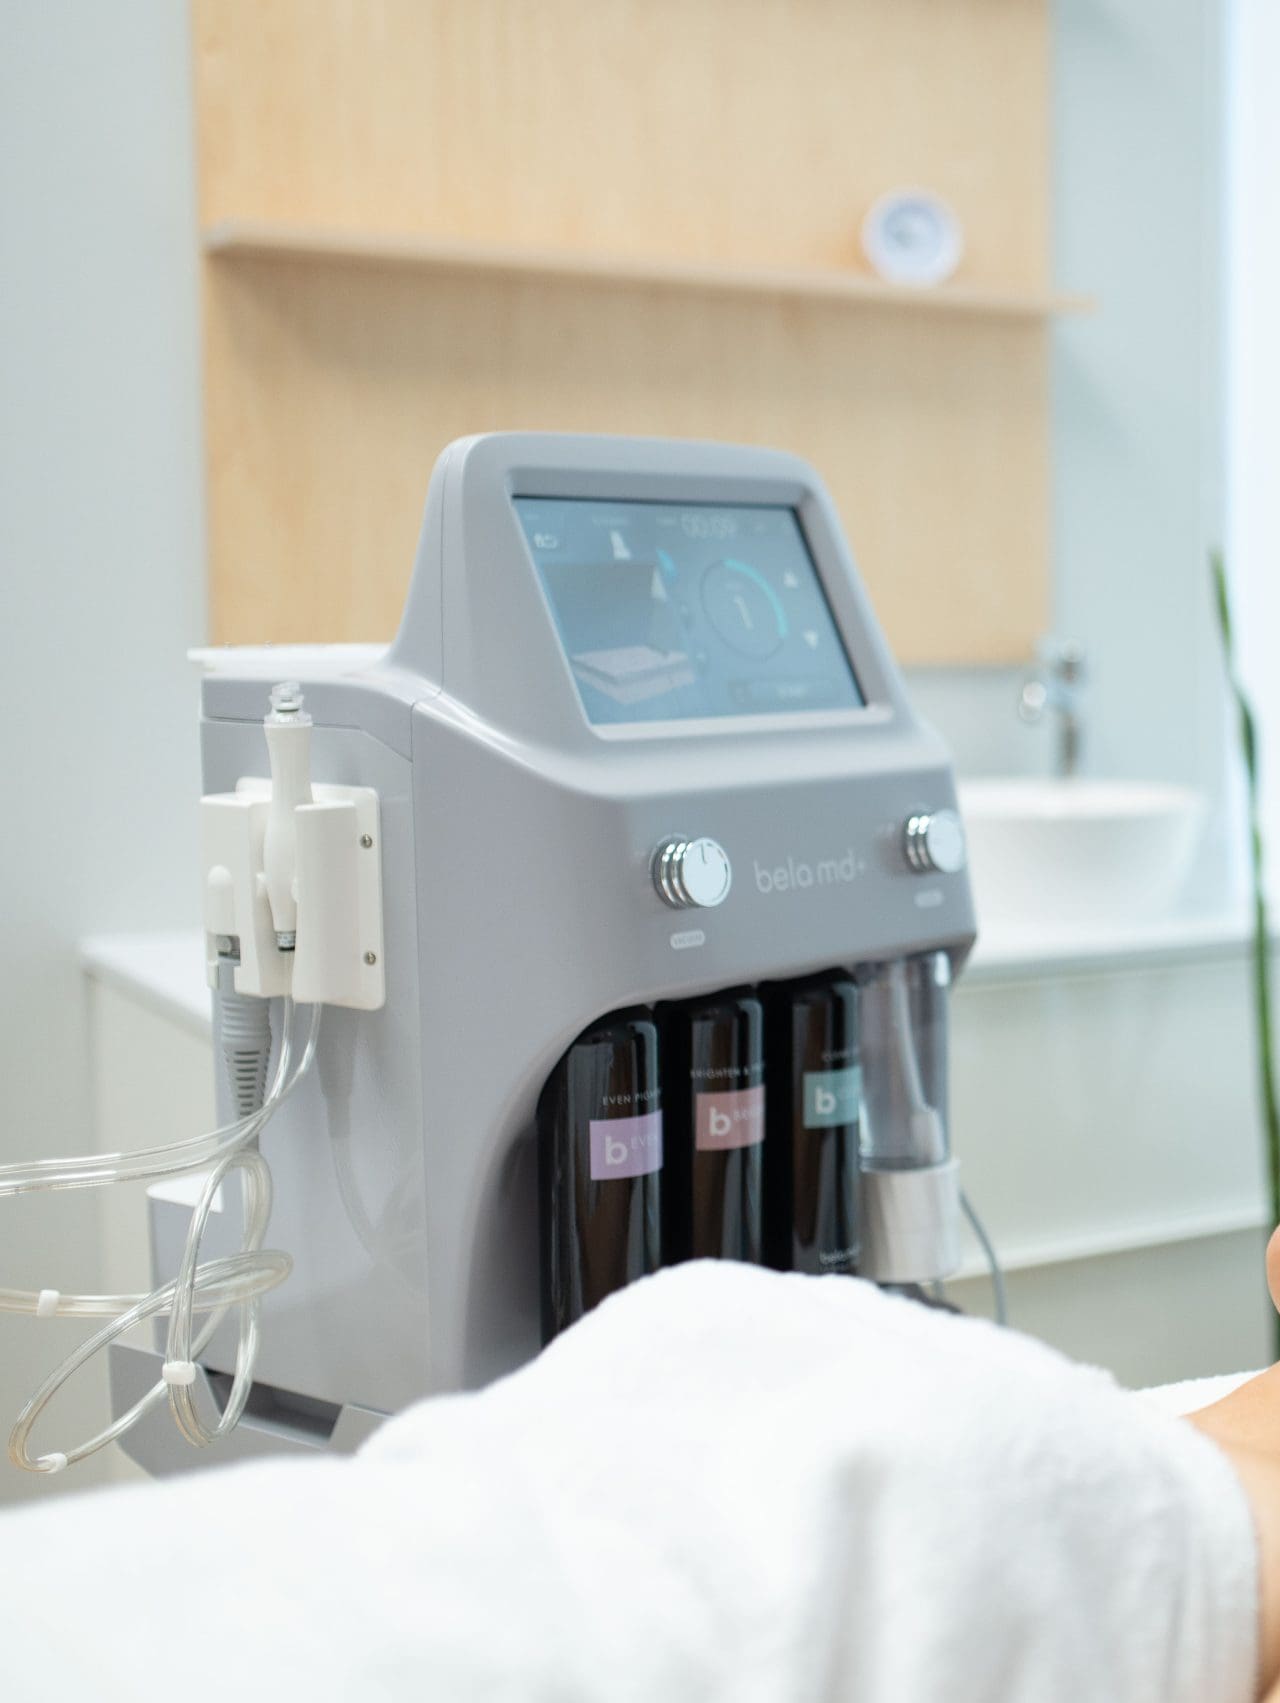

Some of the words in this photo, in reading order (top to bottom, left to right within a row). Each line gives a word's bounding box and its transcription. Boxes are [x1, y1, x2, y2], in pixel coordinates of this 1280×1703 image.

[753, 855, 813, 893] bela
[602, 1093, 632, 1106] EVEN
[815, 1086, 836, 1114] b
[710, 1105, 731, 1136] b
[605, 1134, 628, 1165] b
